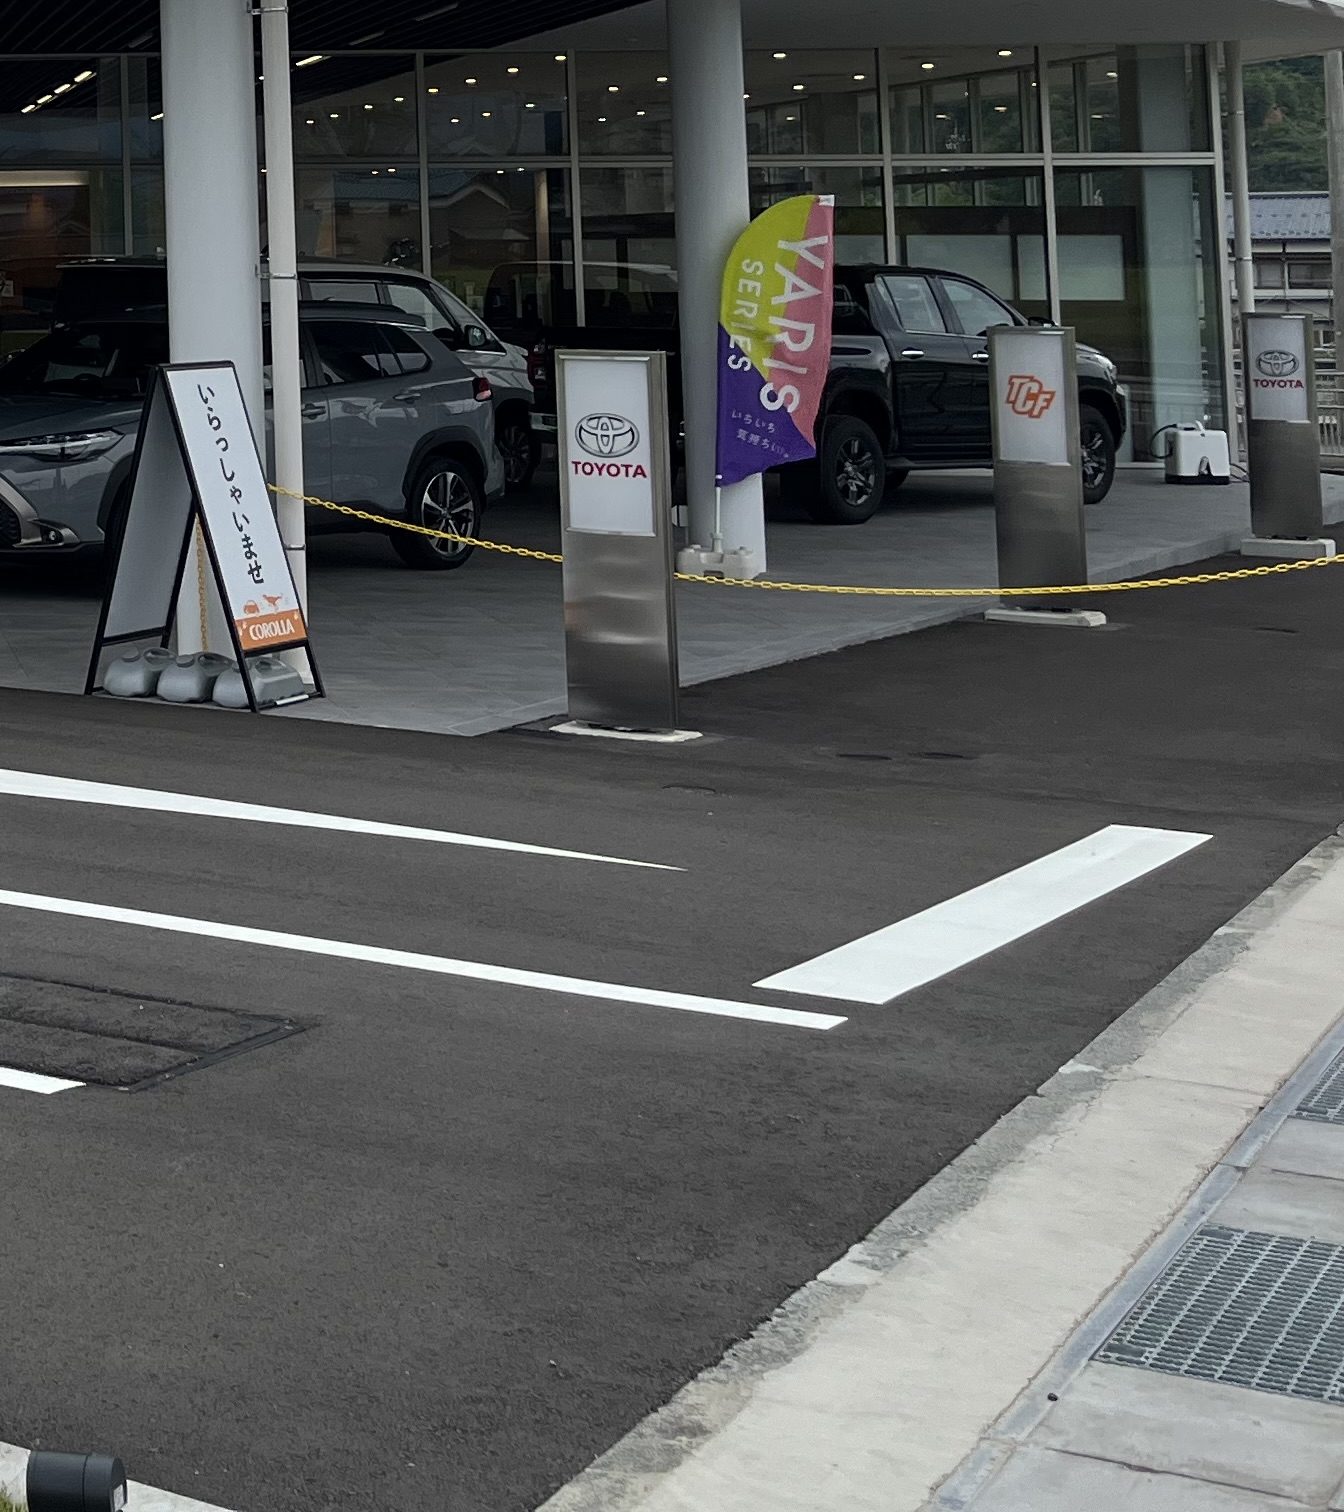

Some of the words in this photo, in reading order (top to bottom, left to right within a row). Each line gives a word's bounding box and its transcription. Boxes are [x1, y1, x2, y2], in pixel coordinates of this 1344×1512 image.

[727, 258, 765, 373] SERIES
[759, 235, 830, 413] YARIS
[1005, 374, 1057, 419] TCF
[1253, 378, 1305, 389] TOYOTA
[197, 383, 265, 585] いらっしゃいませ
[571, 460, 648, 479] TOYOTA
[249, 618, 296, 641] COROLLA
